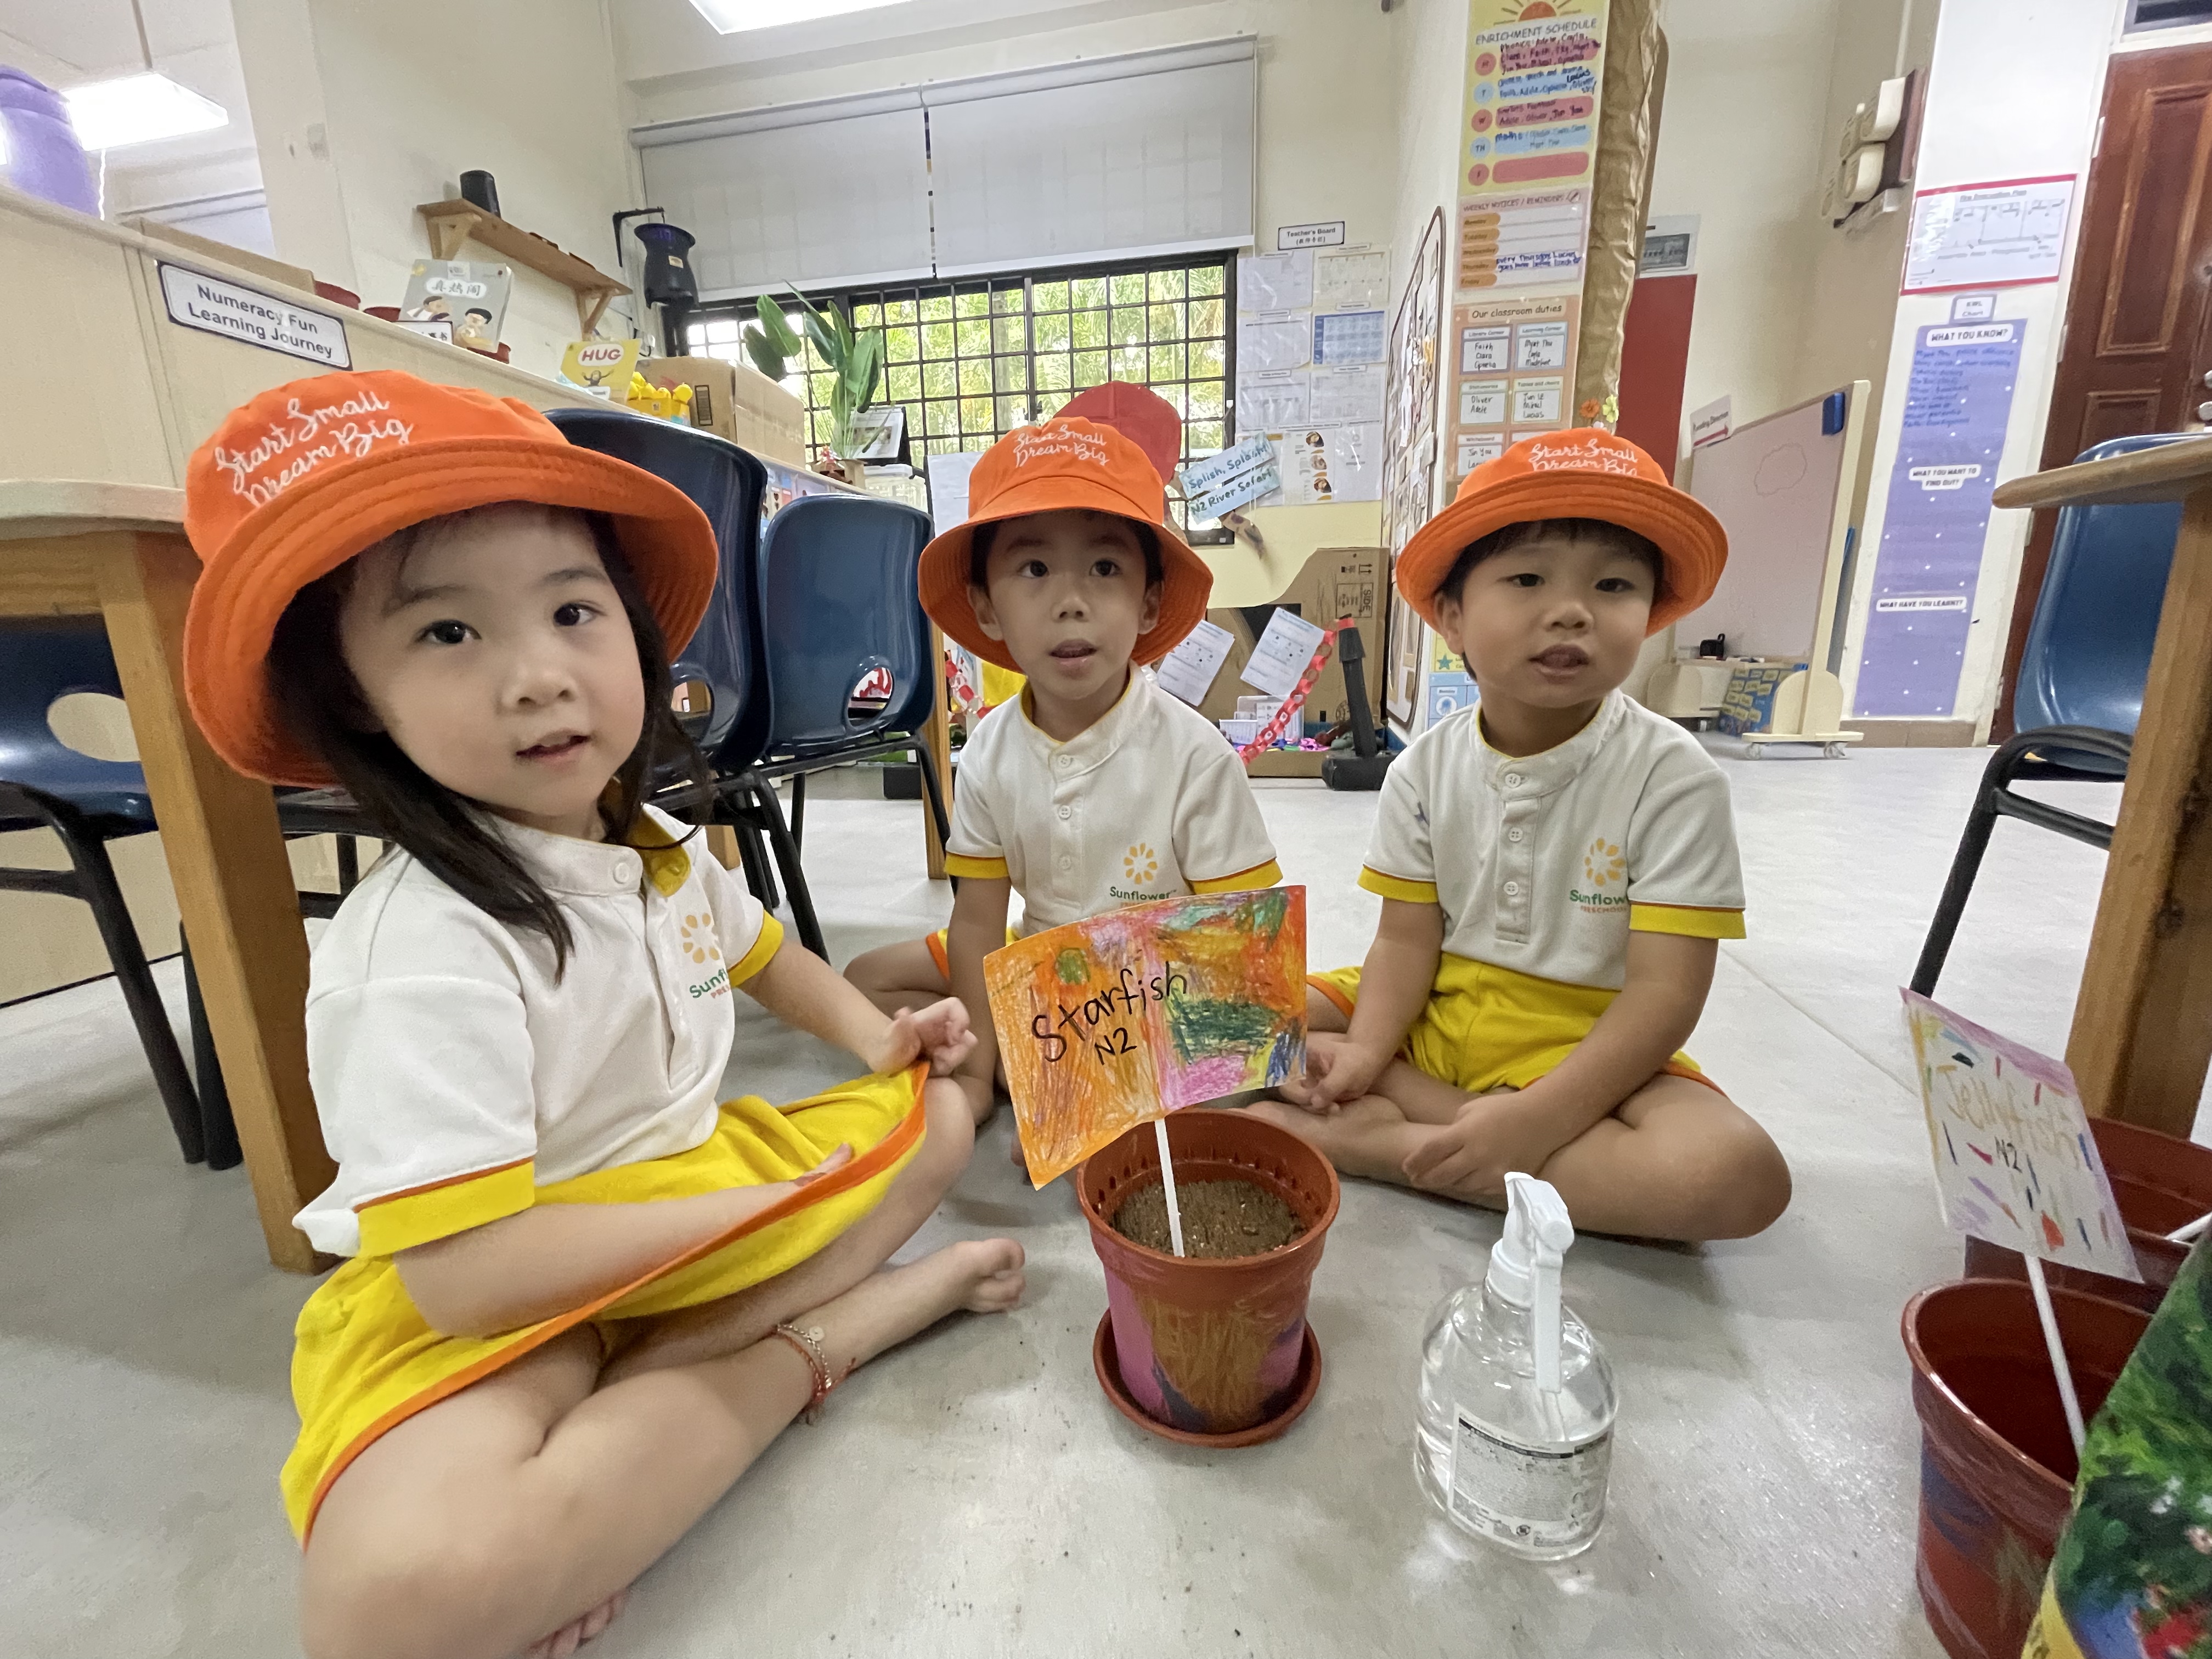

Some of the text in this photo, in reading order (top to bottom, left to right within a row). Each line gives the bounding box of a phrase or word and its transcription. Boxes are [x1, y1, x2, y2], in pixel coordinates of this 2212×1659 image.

[1475, 18, 1597, 45] ENRICHMENT SCHEDULE
[1464, 202, 1489, 212] WEEKLY
[1491, 198, 1519, 209] NOTICES
[1526, 194, 1564, 204] REMINDERS
[196, 283, 318, 335] Numeracy Fun
[1472, 304, 1562, 319] Our classroom duties
[188, 302, 332, 358] Learning Journey
[1931, 329, 2008, 341] WHAT YOU KNOW?
[582, 348, 622, 362] HUG
[1474, 342, 1493, 351] Faith
[1471, 396, 1494, 404] Oliver
[215, 391, 390, 494] Start Small
[1013, 424, 1108, 454] Start Small
[1528, 438, 1639, 463] Start Small
[242, 419, 414, 509] Dream Big
[1015, 441, 1110, 469] Dream Big
[1531, 459, 1602, 472] Dream
[1188, 467, 1232, 489] Splish,
[1190, 501, 1208, 516] N2
[1207, 488, 1237, 508] River
[1362, 589, 1372, 611] SIDE
[1109, 886, 1171, 901] Sunflower
[1569, 889, 1626, 905] Sunflow
[1031, 960, 1188, 1063] Starfish
[1094, 1027, 1137, 1065] N2
